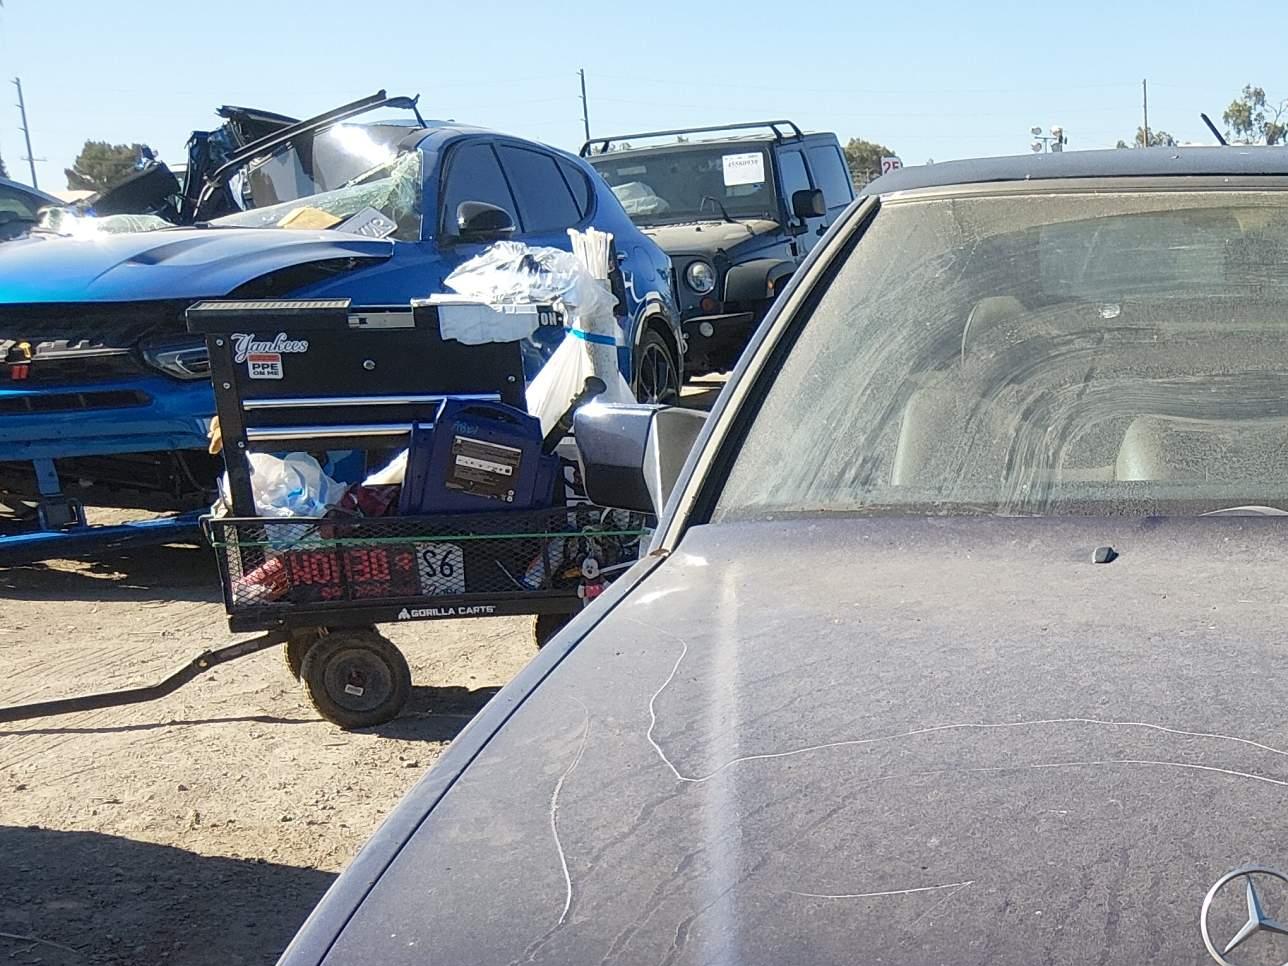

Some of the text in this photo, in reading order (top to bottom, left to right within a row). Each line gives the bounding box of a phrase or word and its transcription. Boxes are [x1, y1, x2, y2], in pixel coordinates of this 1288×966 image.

[231, 332, 309, 363] Yankees
[252, 363, 279, 371] PPE
[411, 605, 494, 618] GORILLA CARTS
